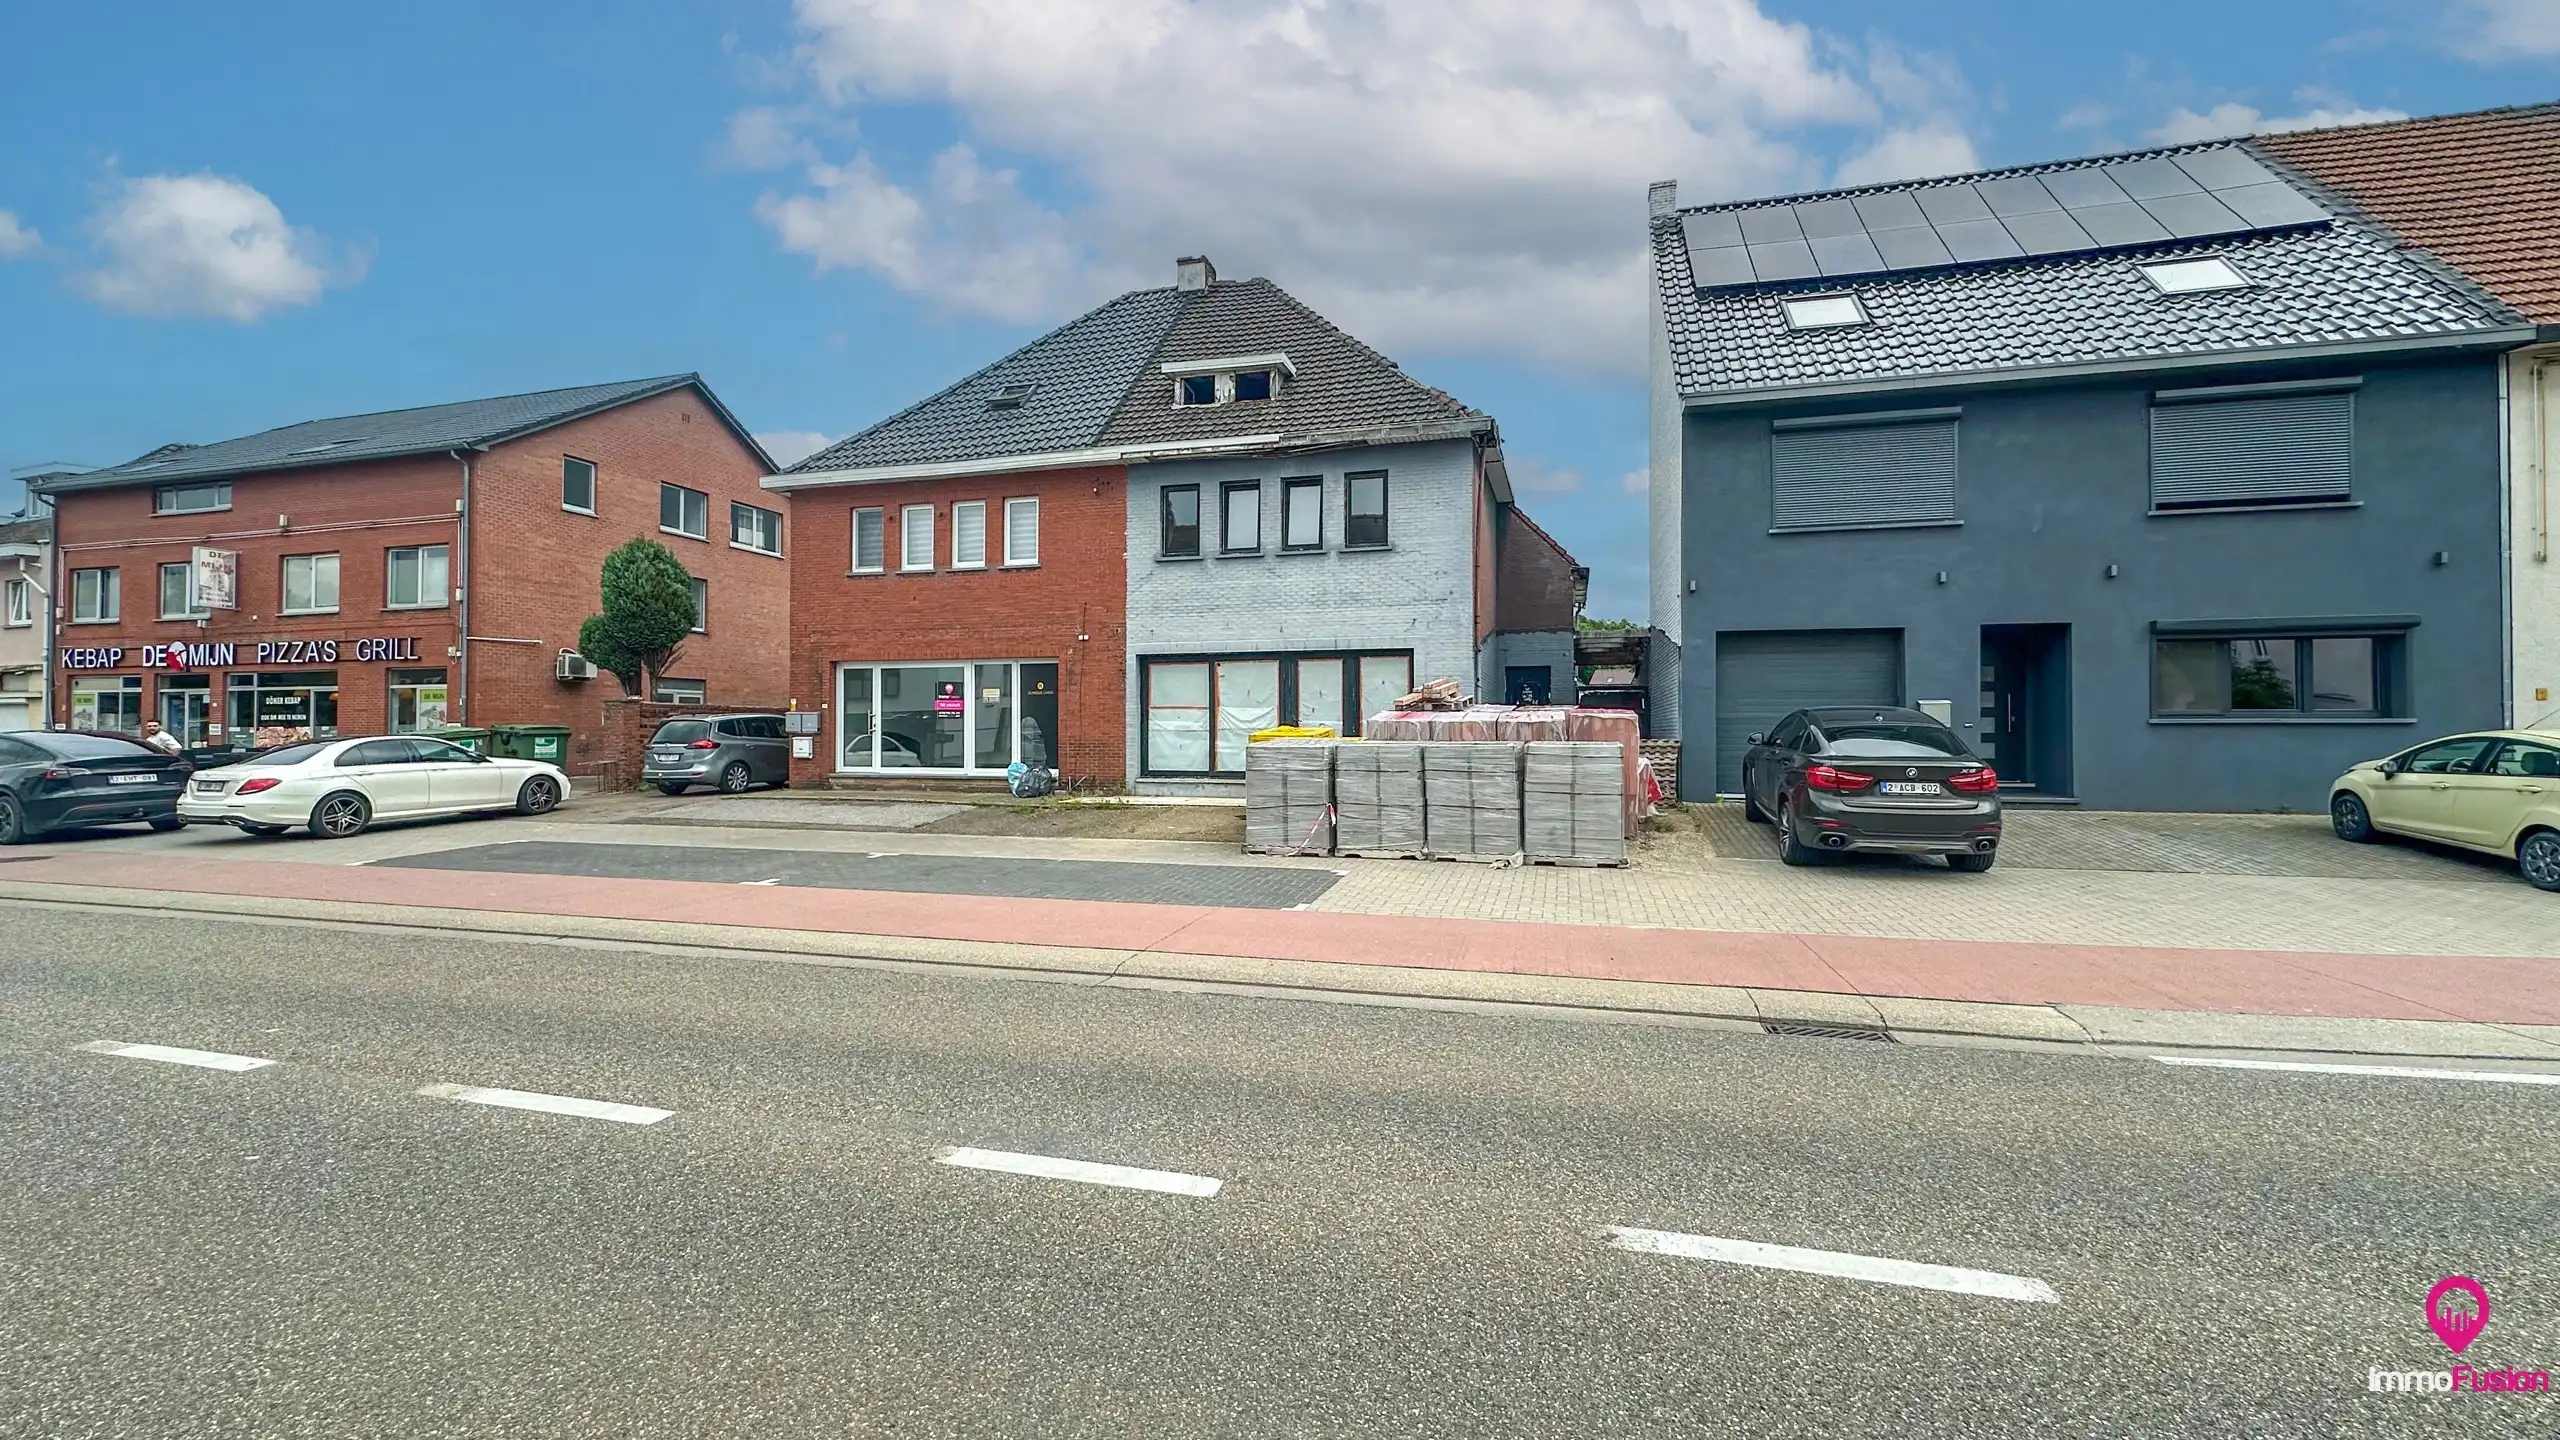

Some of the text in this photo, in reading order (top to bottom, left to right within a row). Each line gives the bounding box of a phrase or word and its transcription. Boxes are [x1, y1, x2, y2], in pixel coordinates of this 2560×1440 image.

[209, 551, 224, 559] DE
[61, 636, 419, 669] KEBAP DE MIJN PIZZA'S GRILL
[265, 695, 302, 705] DÖNER KEBAP
